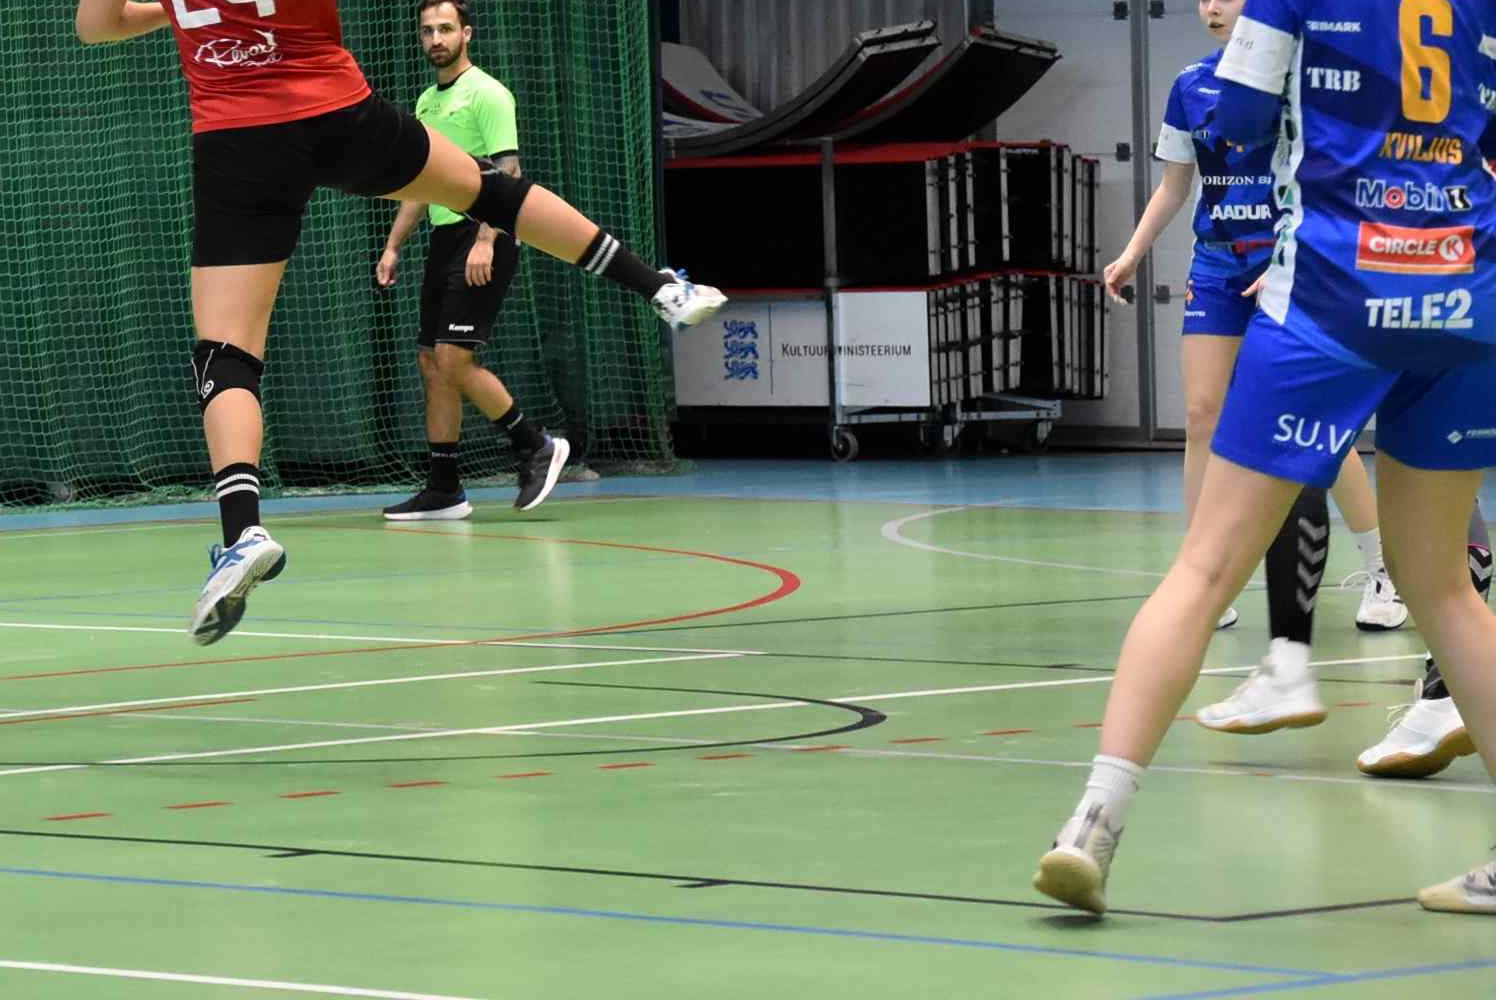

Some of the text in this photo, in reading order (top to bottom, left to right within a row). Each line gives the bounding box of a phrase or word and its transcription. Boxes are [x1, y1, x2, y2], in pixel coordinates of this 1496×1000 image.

[1306, 66, 1362, 93] TRB
[1202, 175, 1255, 186] ORIZON
[1355, 178, 1445, 213] Mobil
[1368, 235, 1438, 257] CIRCLE
[1364, 287, 1474, 330] TELE2
